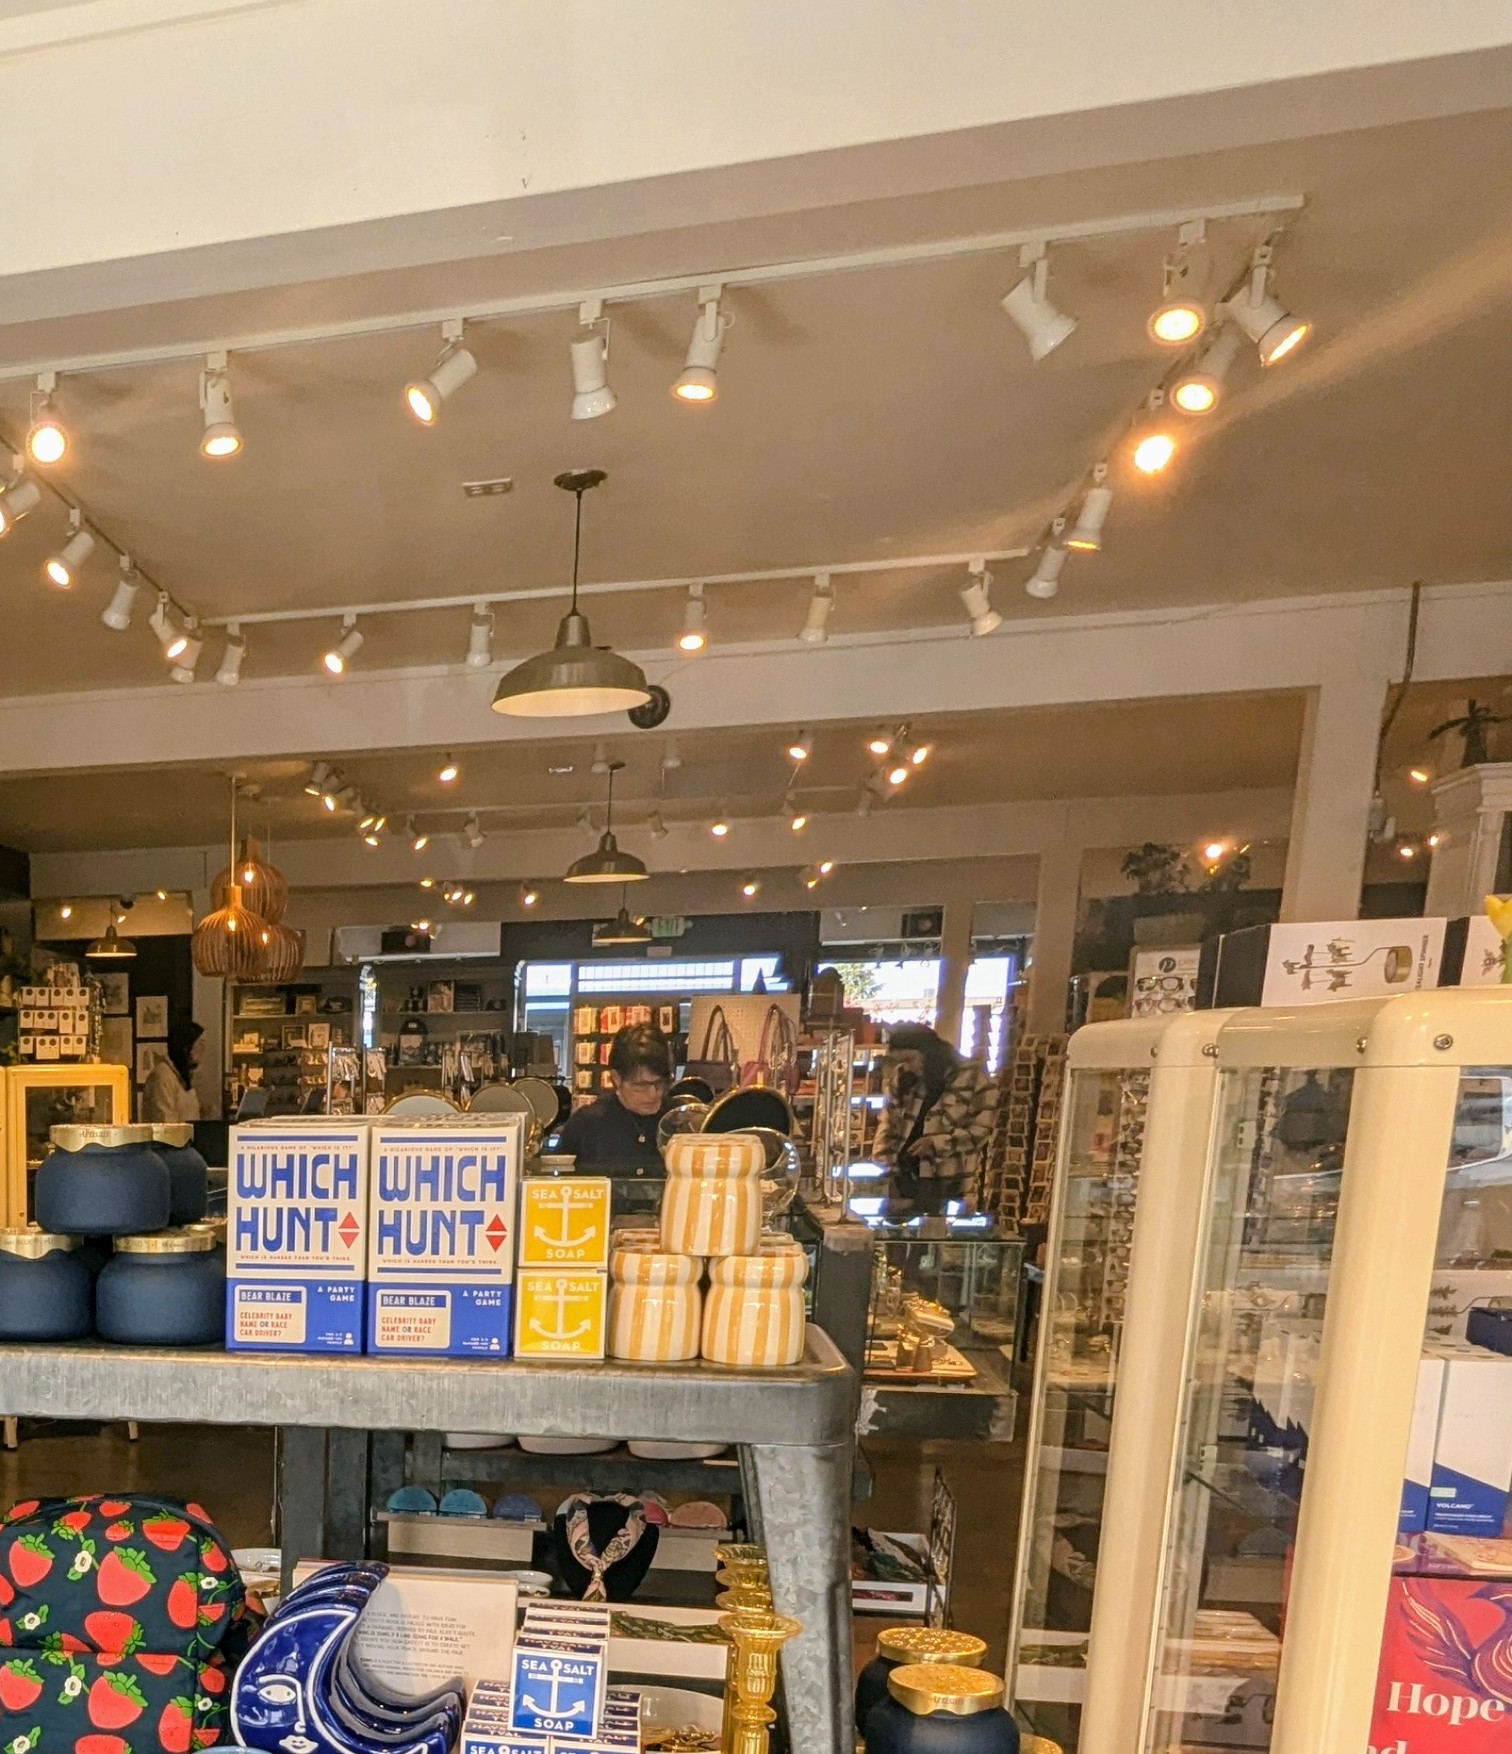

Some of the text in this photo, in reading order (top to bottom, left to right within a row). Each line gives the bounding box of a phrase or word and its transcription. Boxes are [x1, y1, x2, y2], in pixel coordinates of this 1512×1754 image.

[237, 1153, 358, 1200] WHICH
[379, 1155, 506, 1202] WHICH
[531, 1188, 605, 1200] SEA SALT
[236, 1207, 338, 1252] HUNT
[378, 1210, 485, 1256] HUNT
[546, 1248, 585, 1260] SOAP
[527, 1281, 600, 1292] SEA SALT
[241, 1291, 292, 1302] BEAR BLAZE
[330, 1294, 355, 1302] GAME
[473, 1290, 503, 1298] PARTY
[383, 1295, 436, 1306] BEAR BLAZE
[240, 1312, 274, 1320] CELEBRITY
[271, 1321, 288, 1329] RACE
[414, 1326, 432, 1334] RACE
[255, 1329, 282, 1337] DRIVER?
[541, 1341, 581, 1351] SOAP
[522, 1659, 594, 1676] SEA SALT
[1386, 1681, 1506, 1726] Hope
[534, 1717, 575, 1731] SOAP
